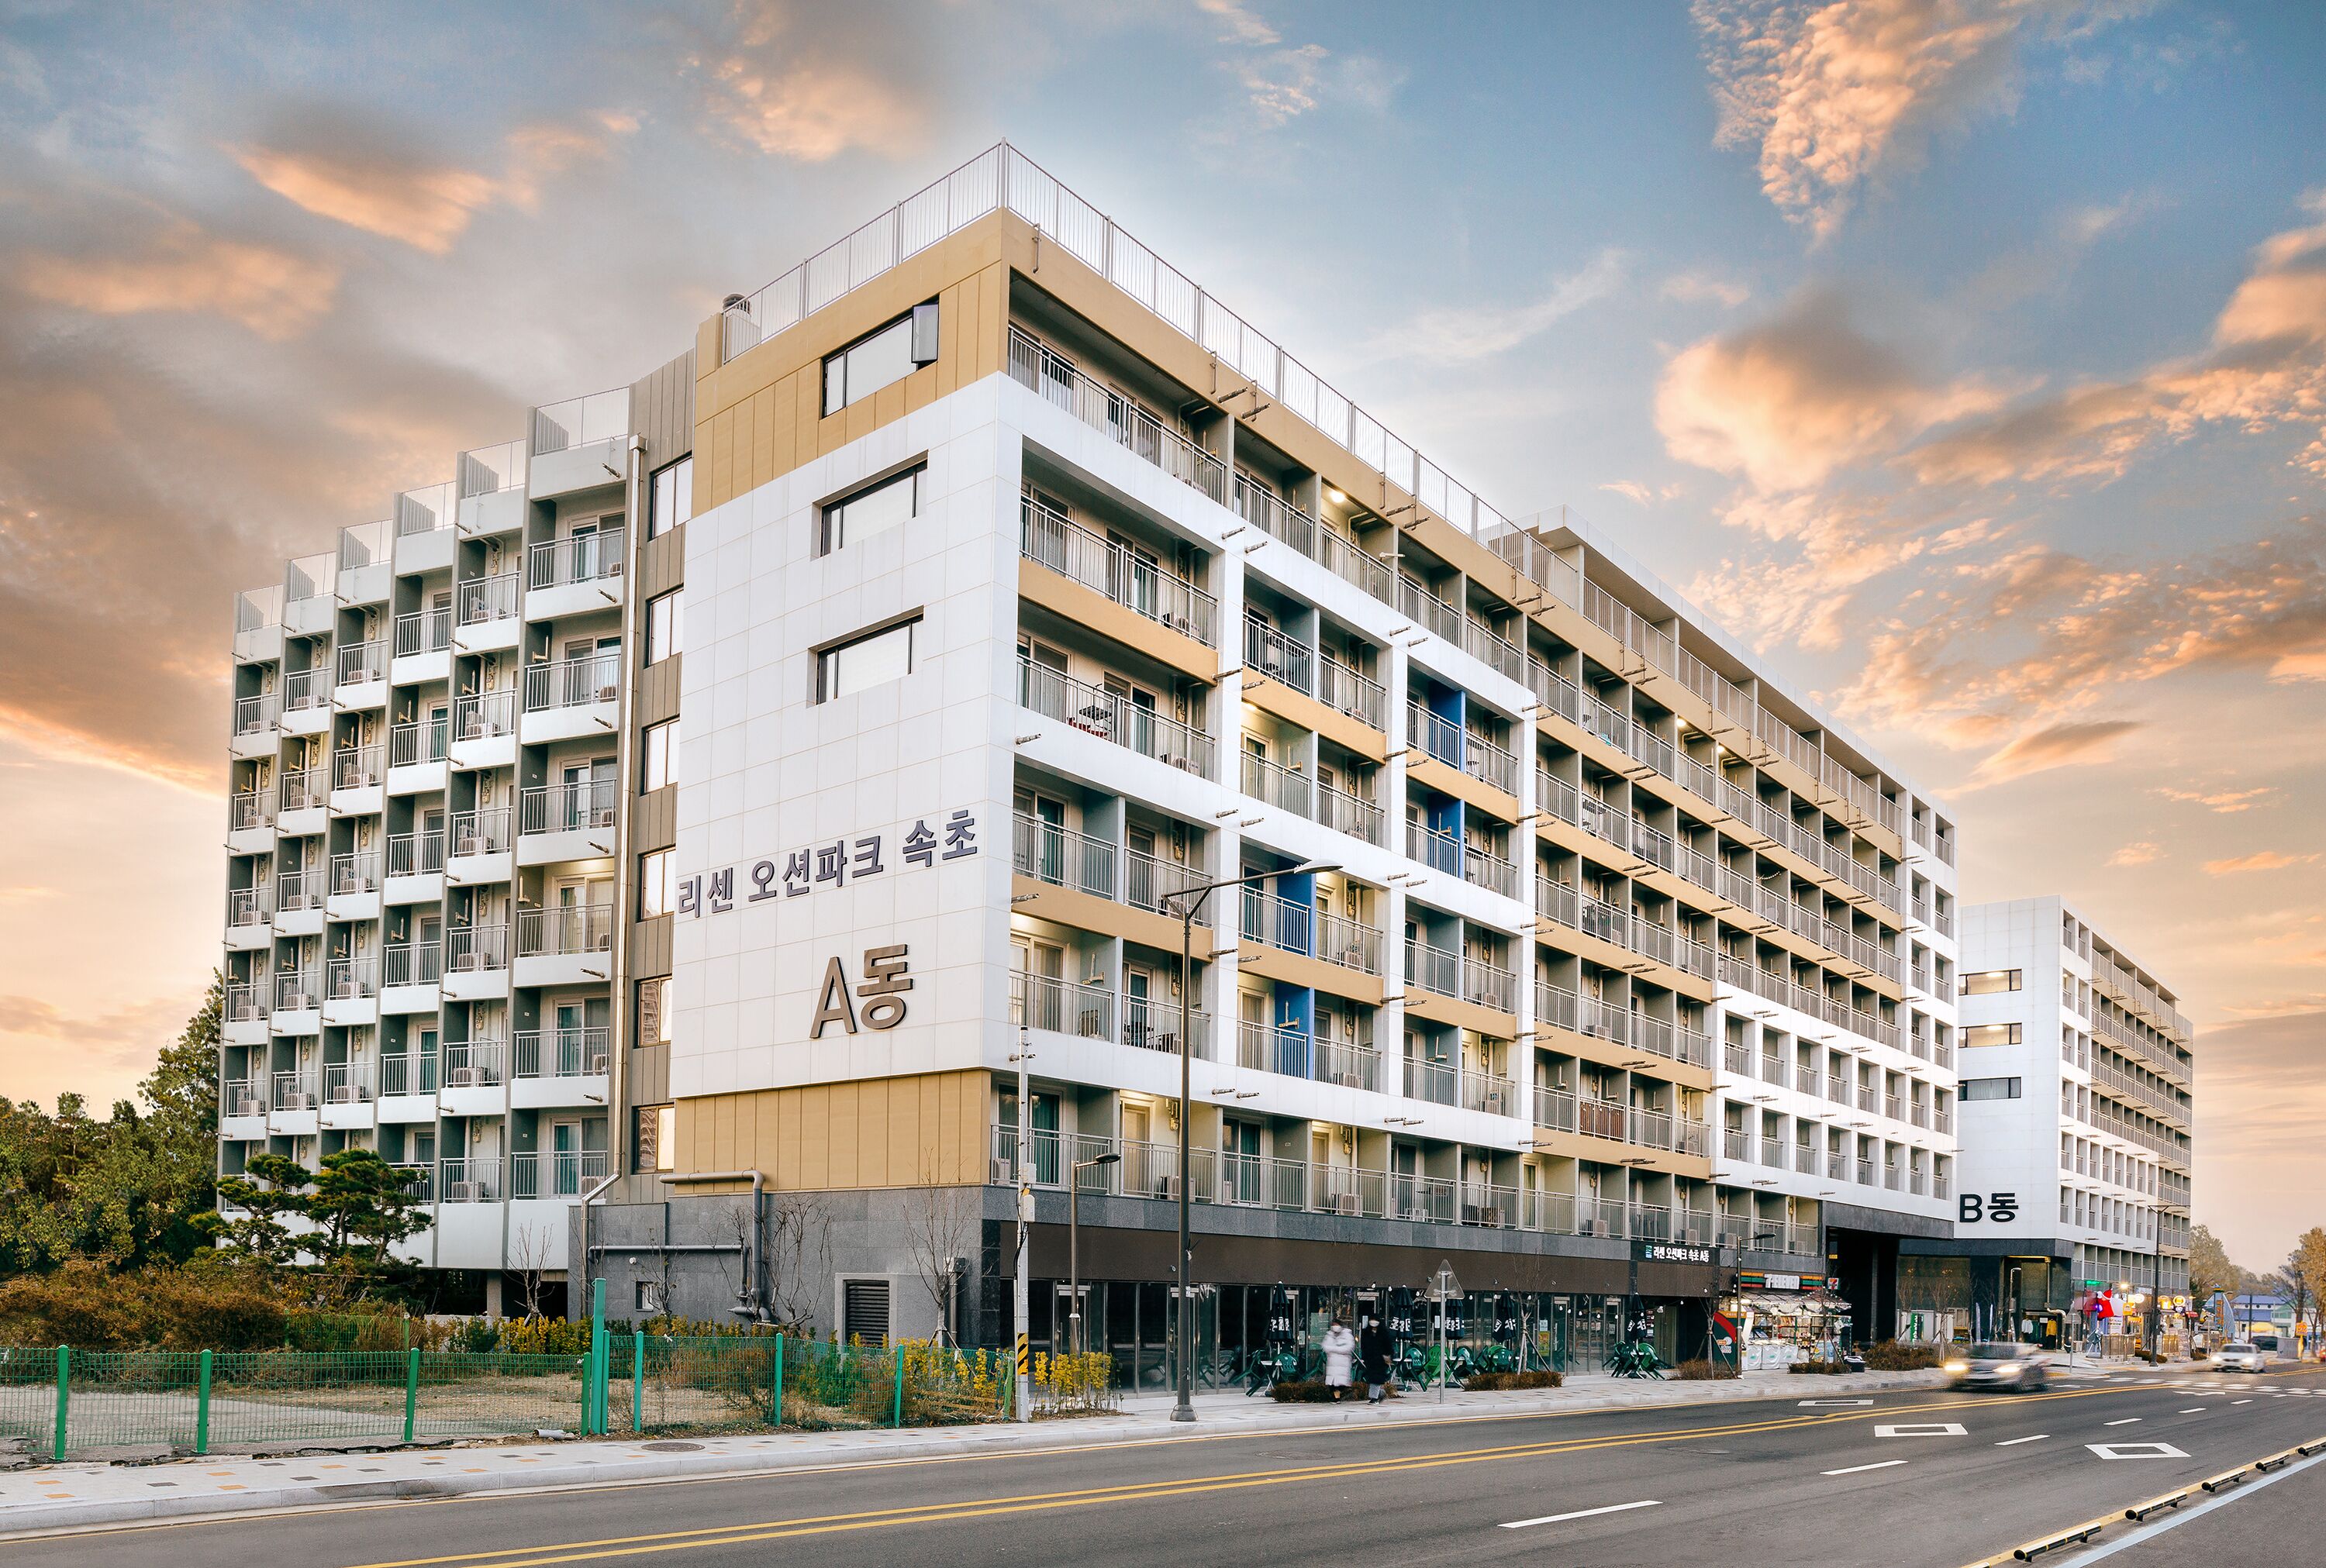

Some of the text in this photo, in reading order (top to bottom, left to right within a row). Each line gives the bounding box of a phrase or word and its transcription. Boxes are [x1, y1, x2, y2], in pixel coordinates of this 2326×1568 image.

[678, 809, 978, 918] 리센 오션파크 속초
[809, 943, 914, 1039] A동
[1958, 1192, 2019, 1223] B동
[1653, 1246, 1710, 1263] 리센 오션파크 속초 A동
